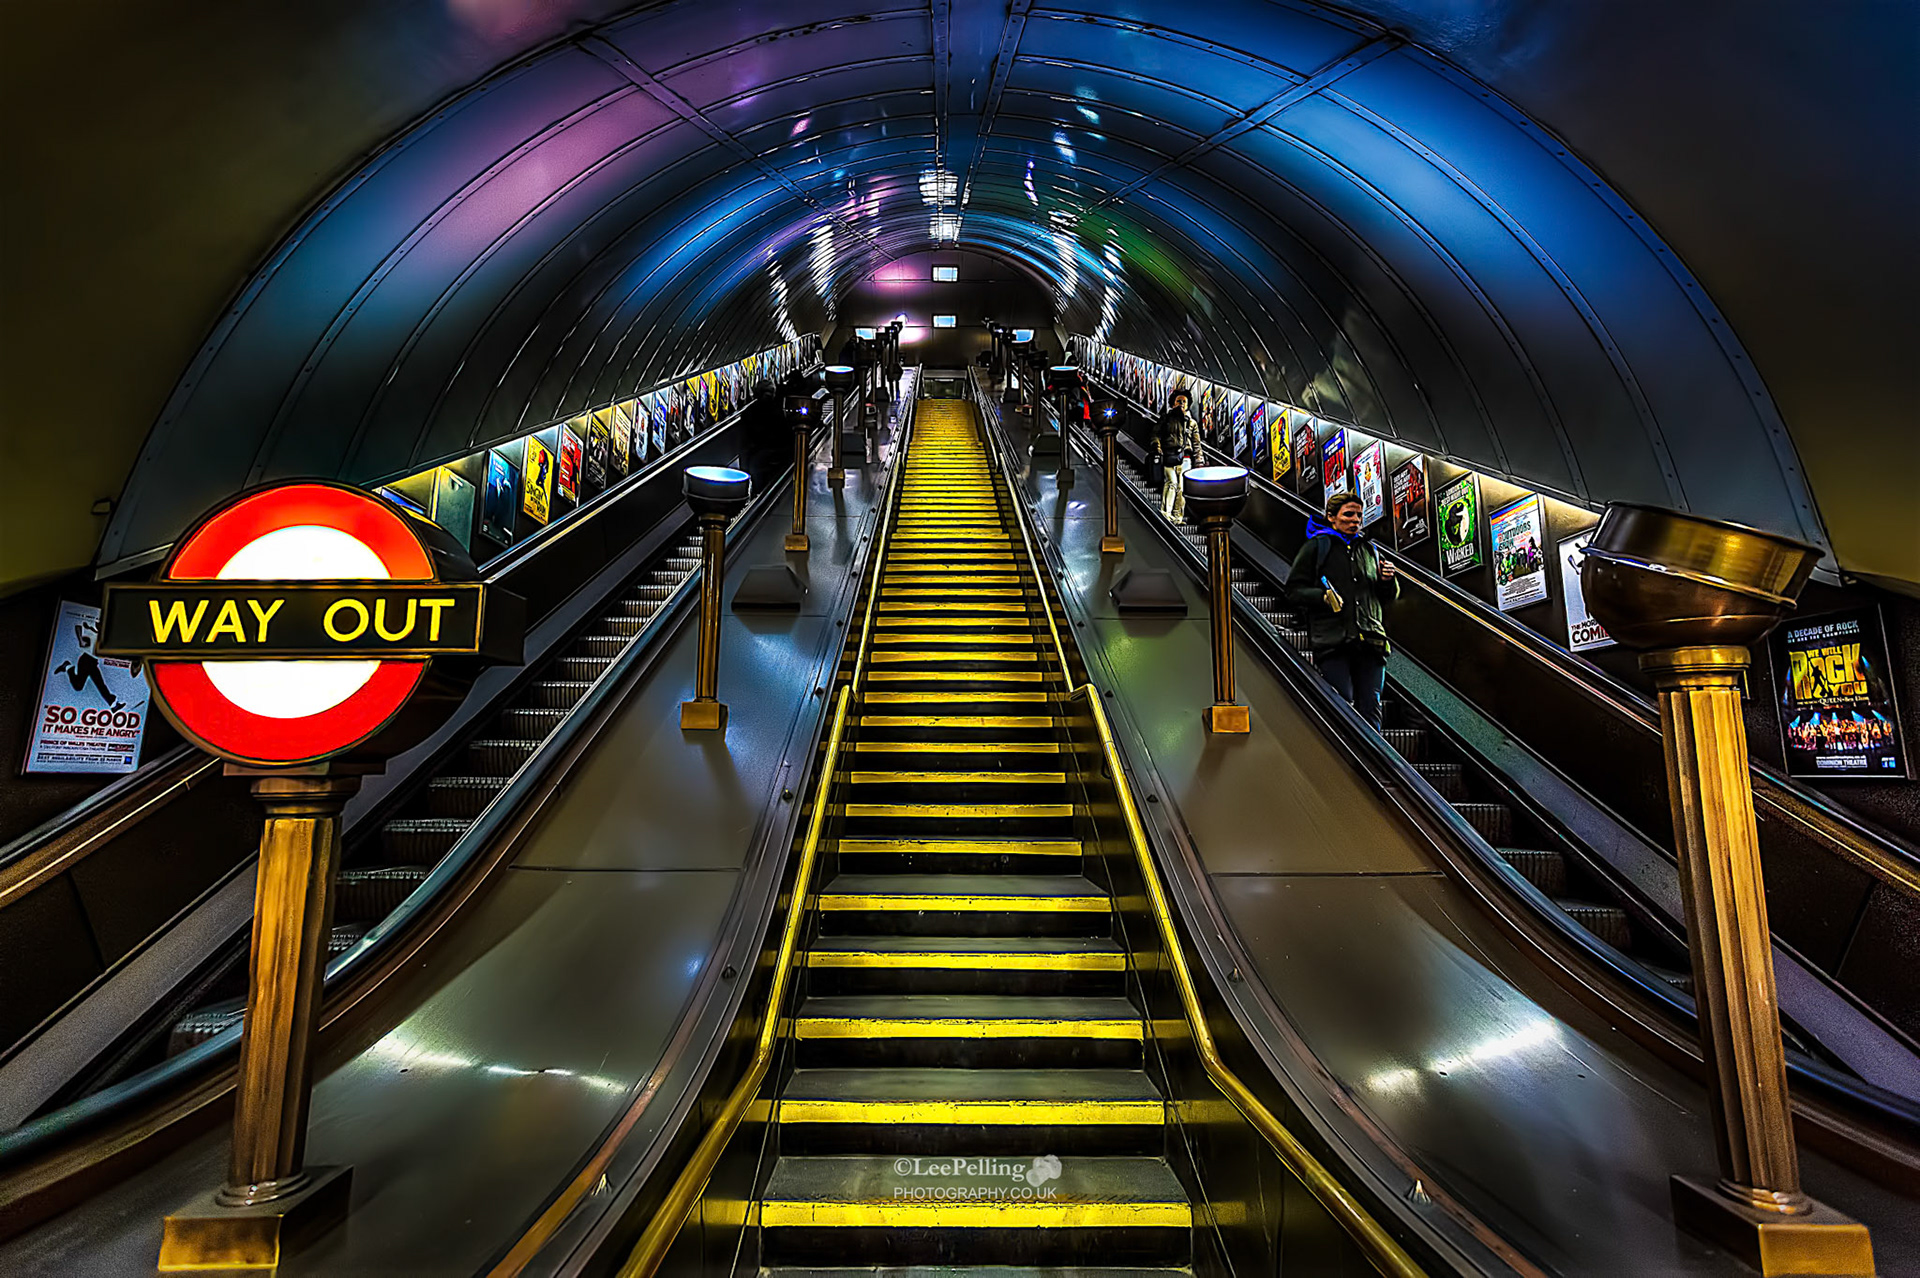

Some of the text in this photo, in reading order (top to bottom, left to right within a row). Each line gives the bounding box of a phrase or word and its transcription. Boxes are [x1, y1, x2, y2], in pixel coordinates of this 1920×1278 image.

[149, 598, 455, 644] WAY OUT
[1581, 620, 1598, 629] MOR
[1787, 620, 1859, 639] A DECADE OF ROCK
[1806, 646, 1843, 658] WE WILL
[1789, 643, 1866, 700] ROCK
[1828, 681, 1868, 697] YOU
[81, 708, 141, 729] GOOD
[42, 724, 54, 733] IT
[54, 724, 89, 735] MAKES
[90, 727, 105, 736] ME
